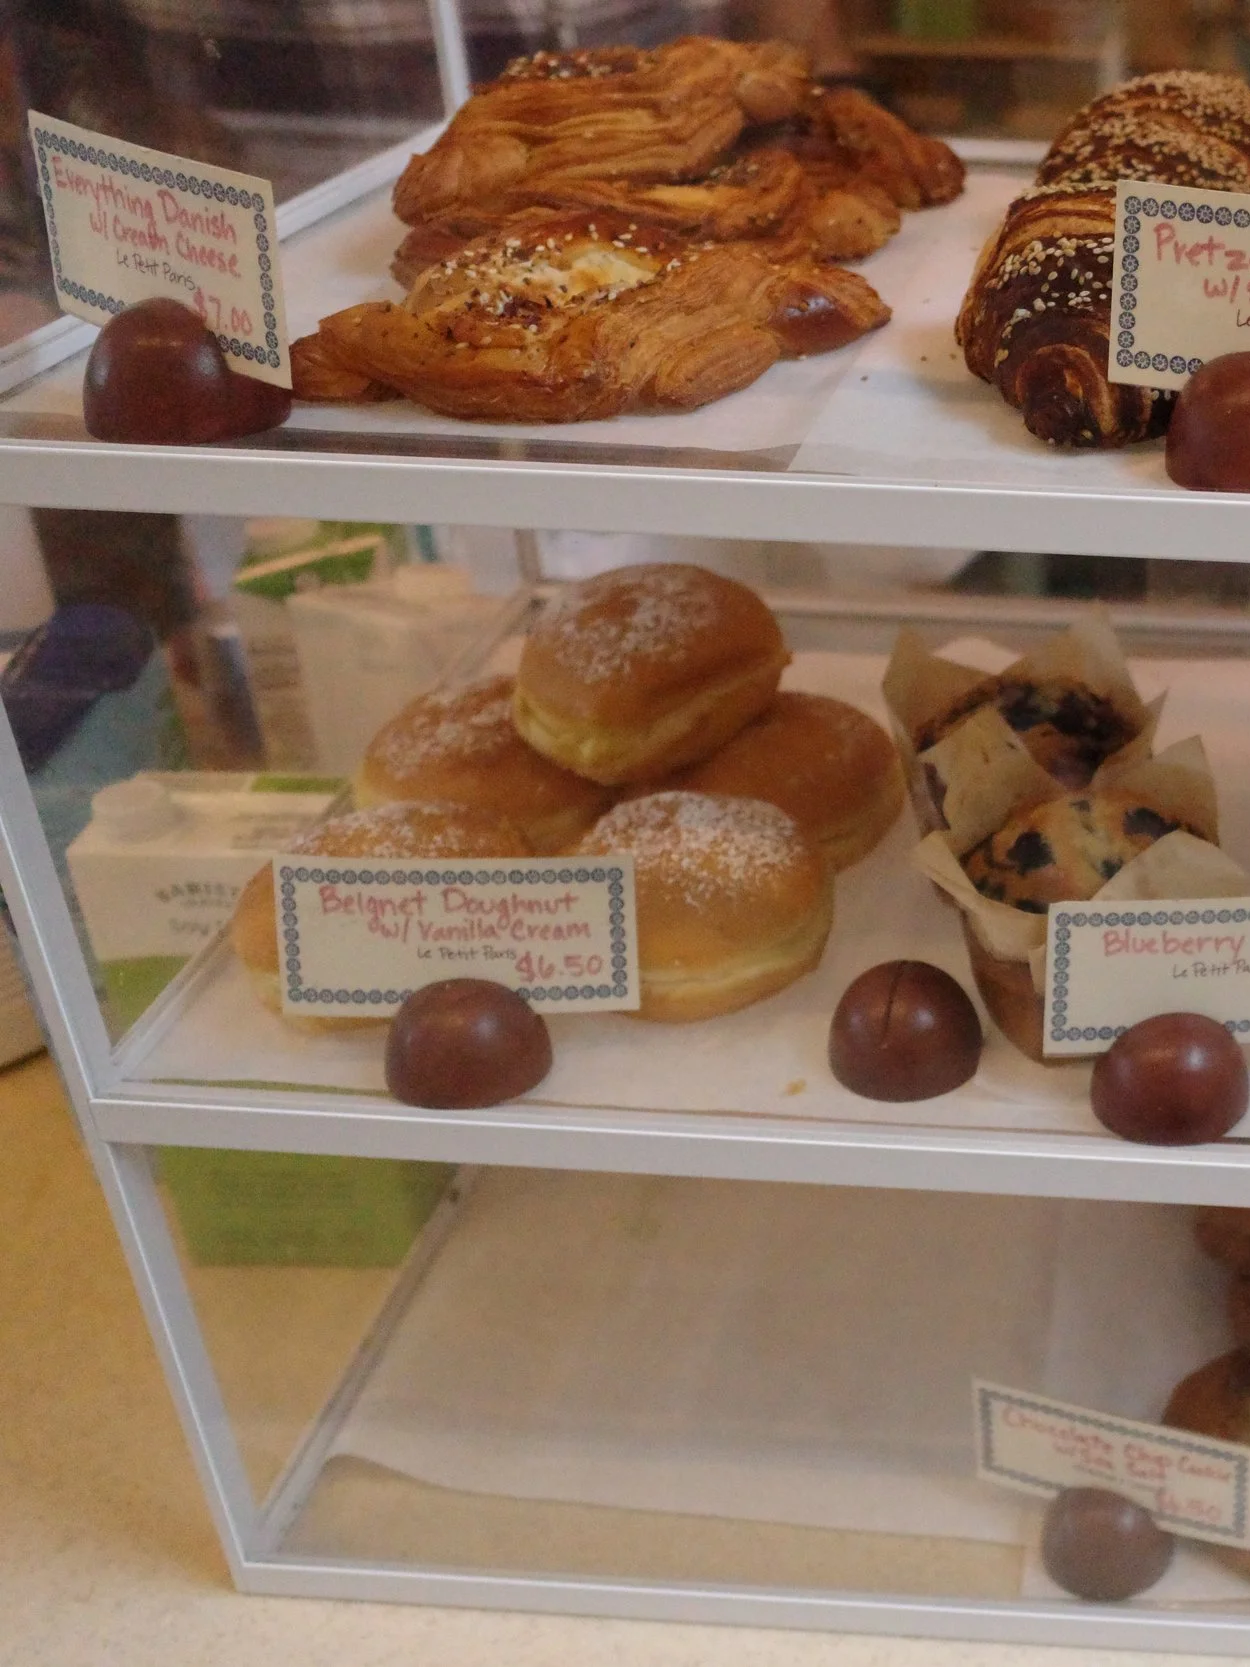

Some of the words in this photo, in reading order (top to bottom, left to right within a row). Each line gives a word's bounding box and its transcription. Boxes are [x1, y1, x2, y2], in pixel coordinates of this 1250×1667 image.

[51, 155, 154, 234] Everything
[157, 188, 237, 245] Danish
[112, 215, 170, 255] Cream
[176, 232, 241, 278] Cheese
[116, 248, 130, 268] Le
[132, 251, 158, 277] Petit
[162, 261, 199, 292] Paris
[1203, 275, 1239, 303] w/
[192, 287, 252, 336] $7.00
[441, 886, 580, 932] Doughnut
[417, 919, 498, 942] Vanilla
[508, 919, 591, 942] Cream
[1103, 929, 1245, 962] Blueberry
[417, 947, 432, 960] Le
[439, 947, 478, 960] Petit
[483, 946, 517, 960] Paris
[515, 951, 604, 983] $6.50
[1172, 964, 1187, 978] Le
[1192, 962, 1228, 978] Petit
